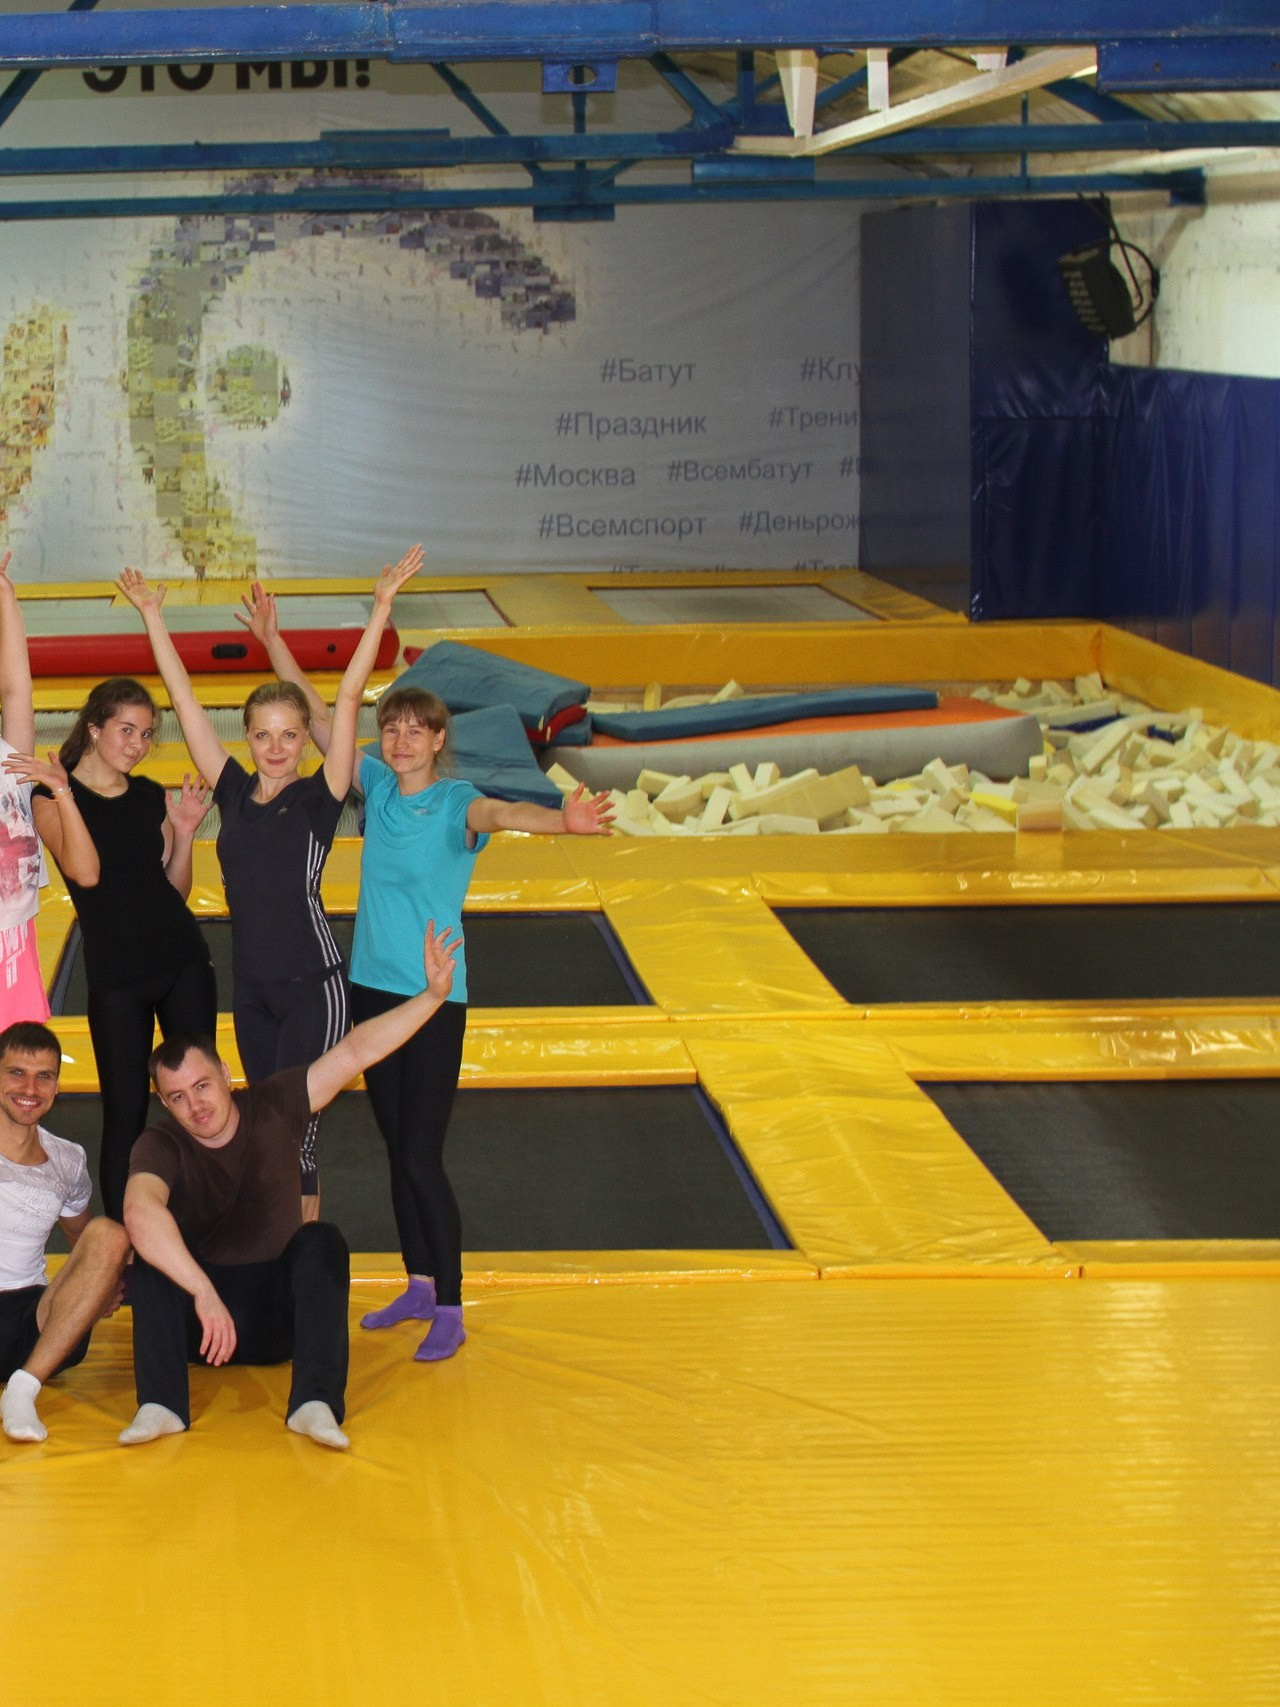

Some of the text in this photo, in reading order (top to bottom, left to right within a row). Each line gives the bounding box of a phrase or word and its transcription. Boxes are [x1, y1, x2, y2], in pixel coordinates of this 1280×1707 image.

[600, 358, 696, 387] #Батут
[556, 411, 708, 440] #Праздник
[516, 463, 636, 488] #Москва
[668, 459, 813, 483] #Всембатут
[538, 512, 707, 541] #Всемспорт
